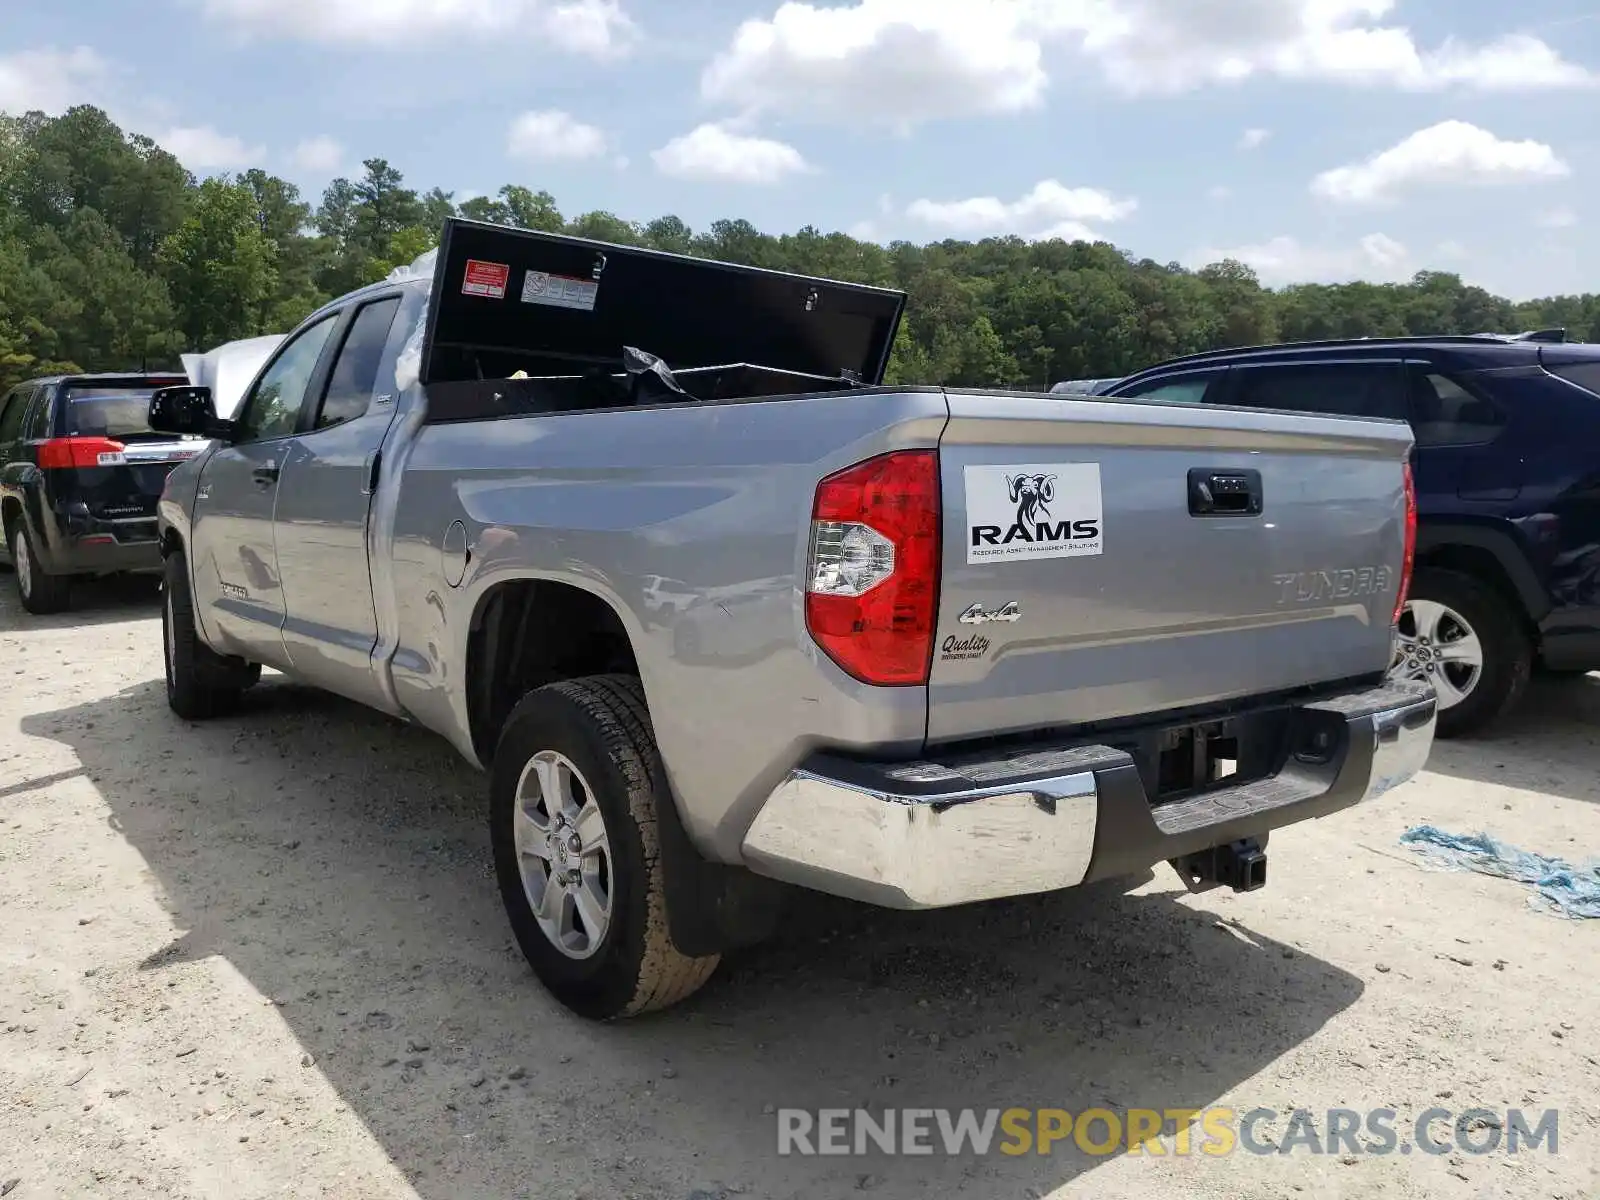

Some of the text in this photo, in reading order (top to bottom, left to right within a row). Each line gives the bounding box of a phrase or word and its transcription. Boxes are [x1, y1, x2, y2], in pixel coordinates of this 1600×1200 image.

[971, 519, 1100, 547] RAMS
[1273, 564, 1393, 603] TUNDRA
[942, 633, 991, 656] Quality
